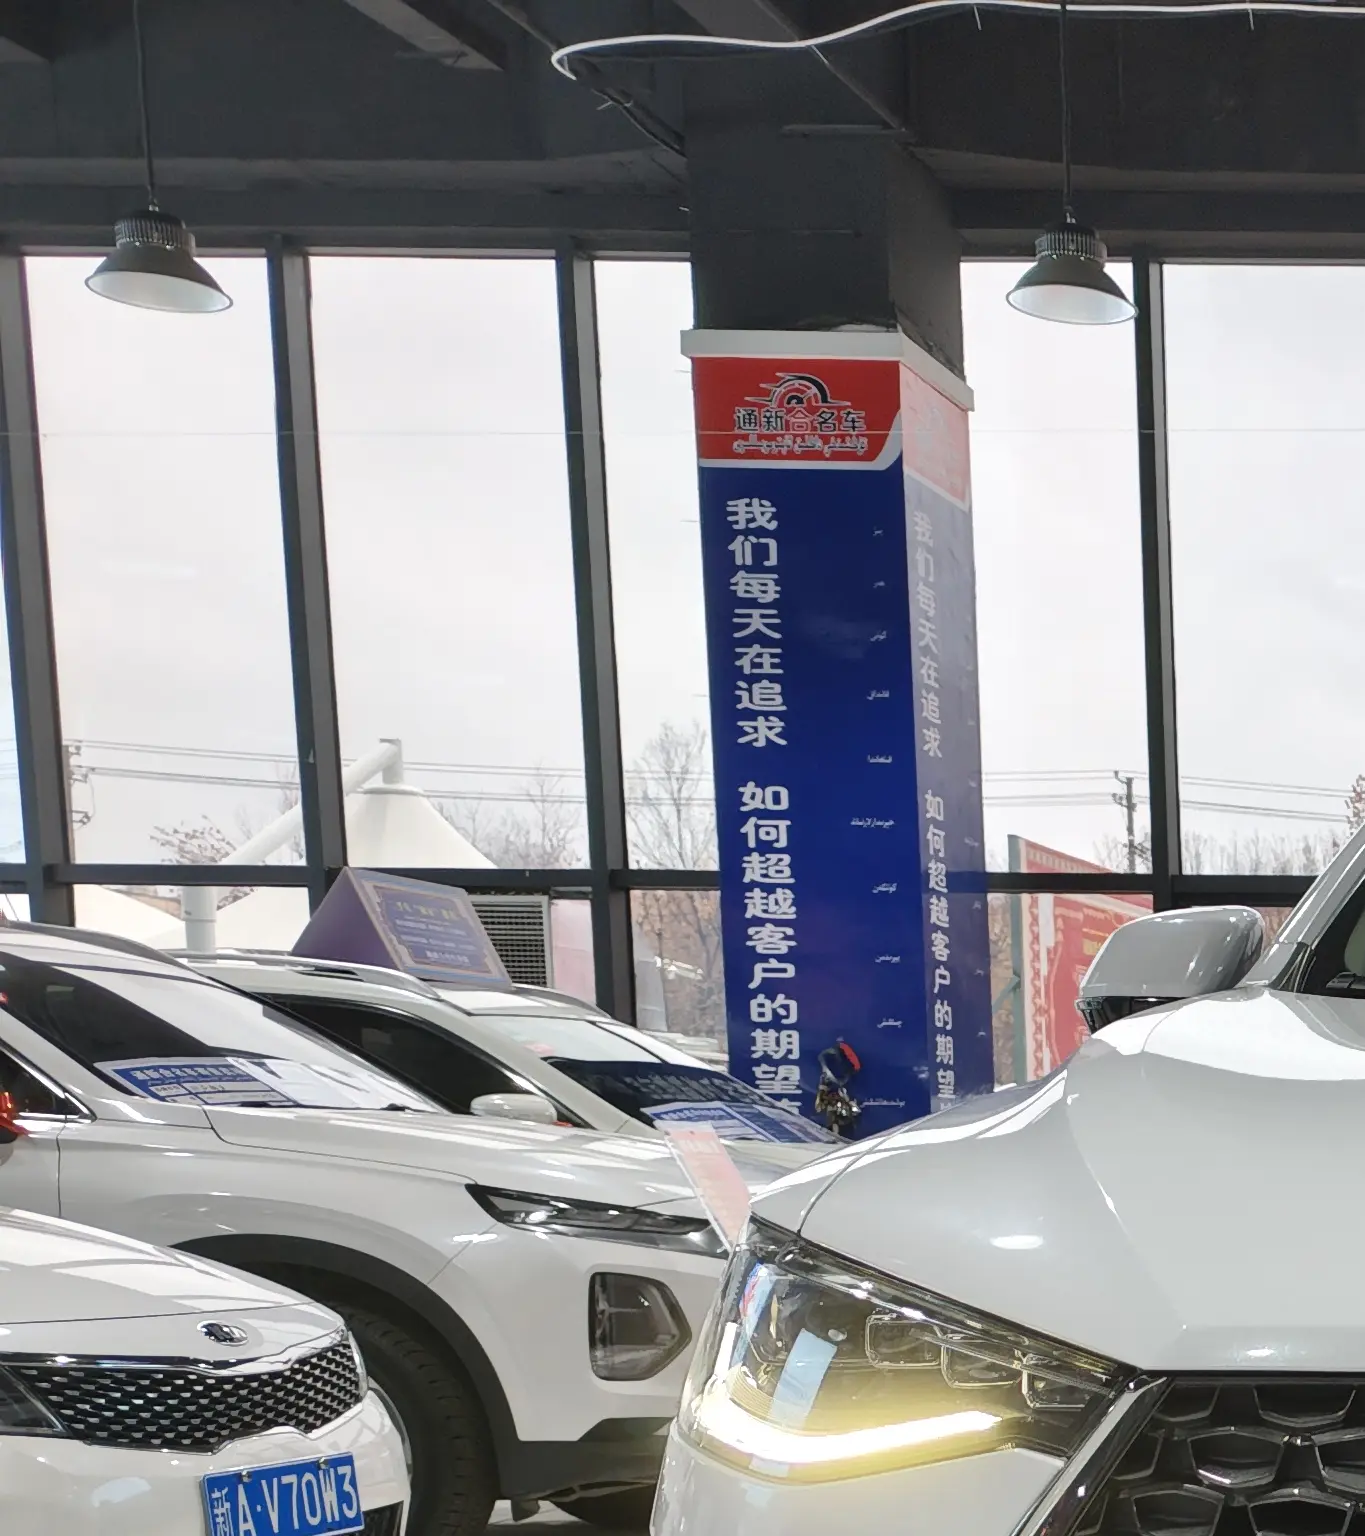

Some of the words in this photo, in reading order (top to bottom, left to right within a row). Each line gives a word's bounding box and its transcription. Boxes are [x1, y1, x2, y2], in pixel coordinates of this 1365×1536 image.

[733, 407, 867, 433] 通新合名车
[726, 497, 788, 748] 我们每天在追求
